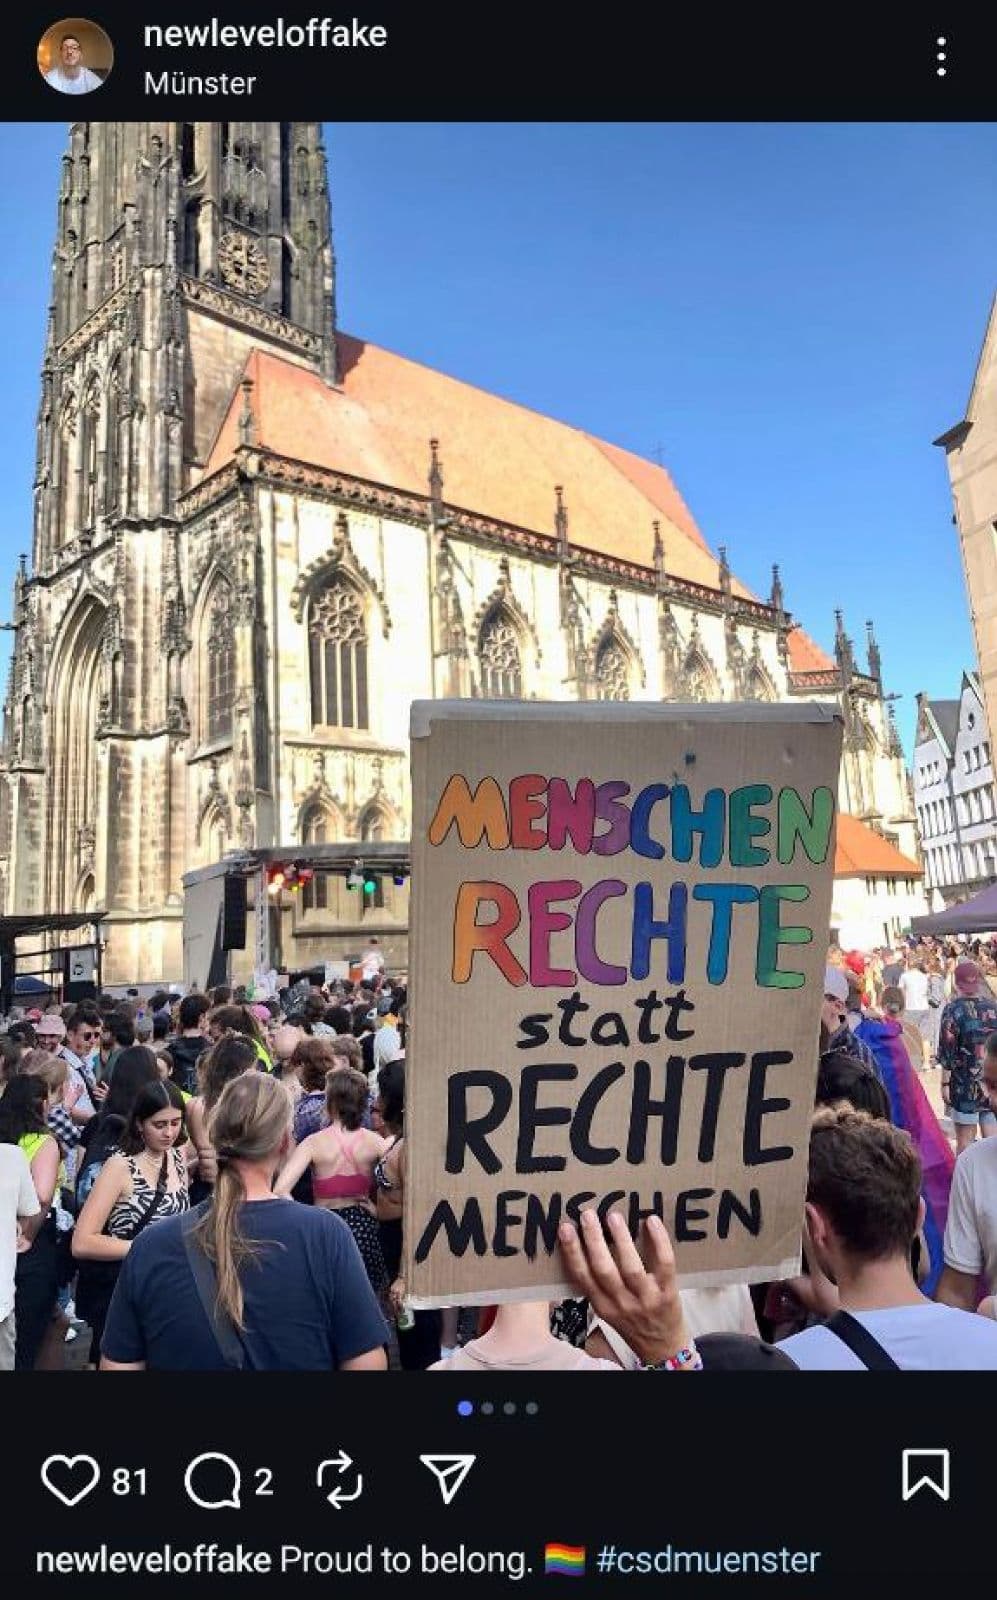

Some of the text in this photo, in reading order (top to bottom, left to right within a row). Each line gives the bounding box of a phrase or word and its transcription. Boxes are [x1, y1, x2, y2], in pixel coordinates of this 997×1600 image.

[429, 774, 835, 868] MENSCHEN
[451, 880, 814, 989] RECHTE
[516, 991, 695, 1049] statt
[445, 1051, 794, 1175] RECHTE
